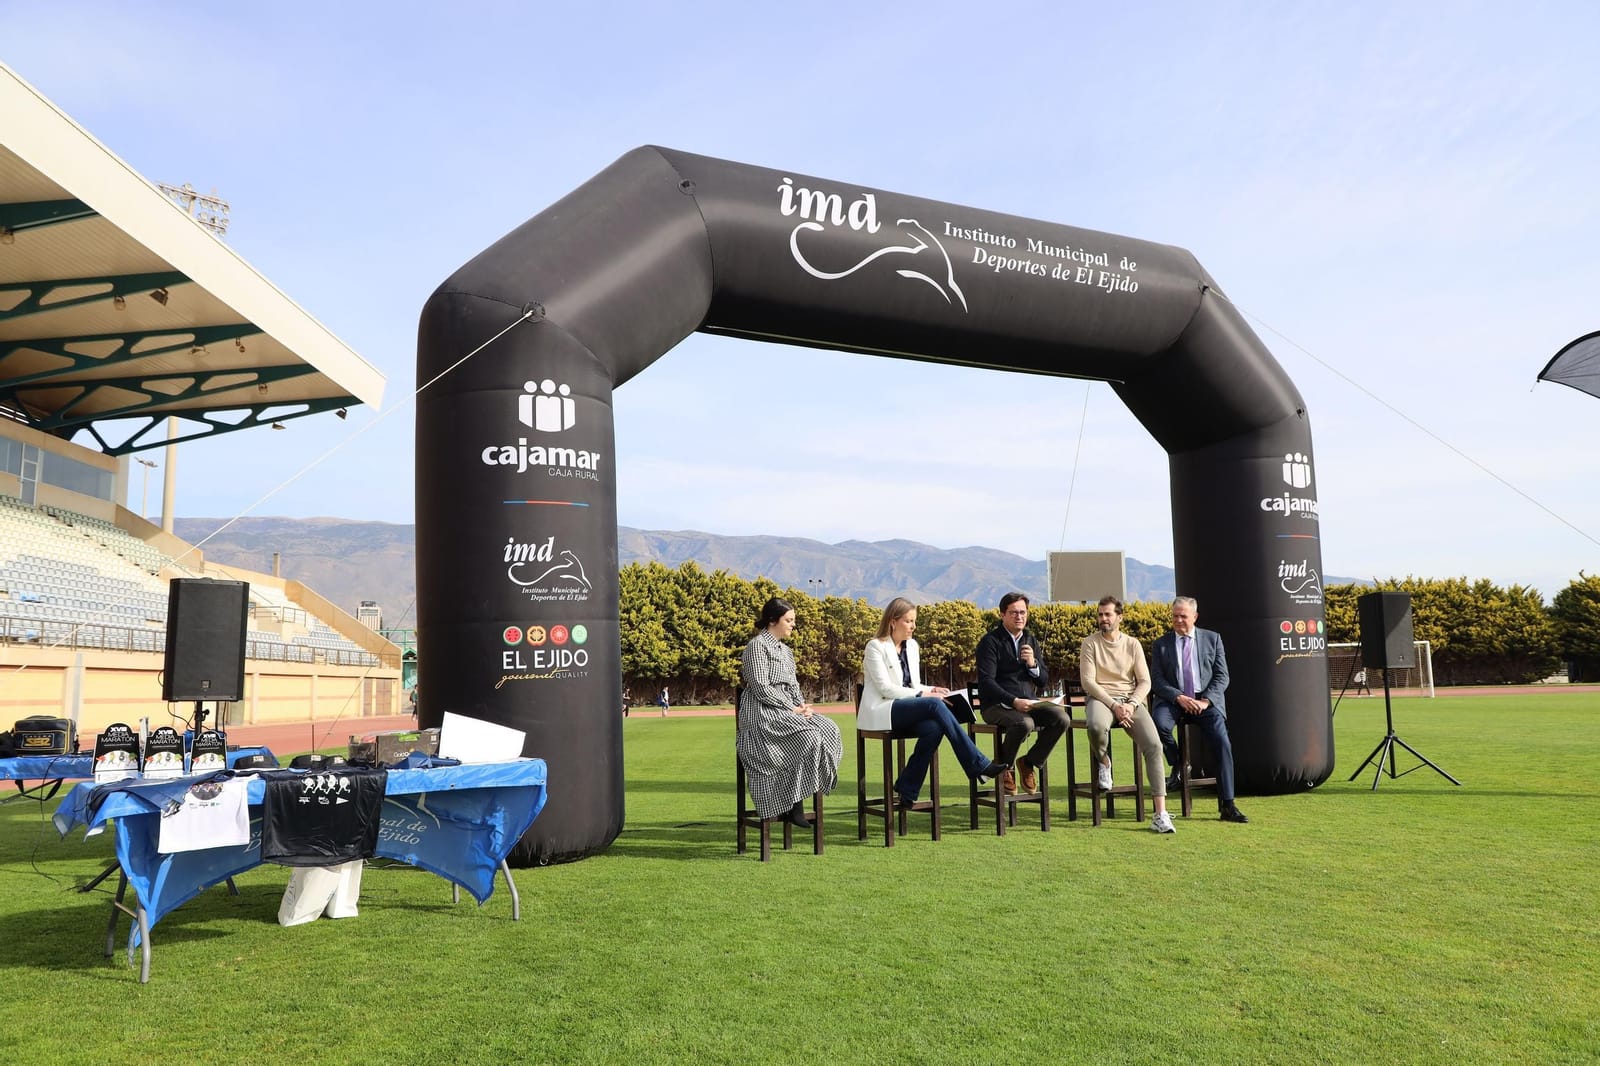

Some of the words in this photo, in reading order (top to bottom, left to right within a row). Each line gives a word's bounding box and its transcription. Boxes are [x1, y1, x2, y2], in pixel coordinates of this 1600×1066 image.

[777, 177, 882, 234] imd
[944, 221, 1016, 248] Instituto
[1026, 237, 1109, 267] Municipal
[1120, 257, 1137, 271] de
[972, 246, 1047, 276] Deportes
[1052, 263, 1070, 280] de
[1075, 267, 1093, 285] El
[1097, 271, 1139, 293] Ejido
[482, 437, 600, 473] cajamar
[548, 468, 573, 478] CAJA
[575, 469, 599, 481] RURAL
[503, 536, 555, 562] imd
[1278, 560, 1307, 577] imd
[1281, 638, 1296, 651] EL
[1300, 637, 1325, 650] EJIDO
[503, 650, 527, 670] EL
[534, 649, 589, 669] EJIDO
[495, 667, 570, 690] gourmet
[556, 671, 589, 679] QUALITY
[379, 827, 420, 845] Ejido
[407, 821, 427, 832] de
